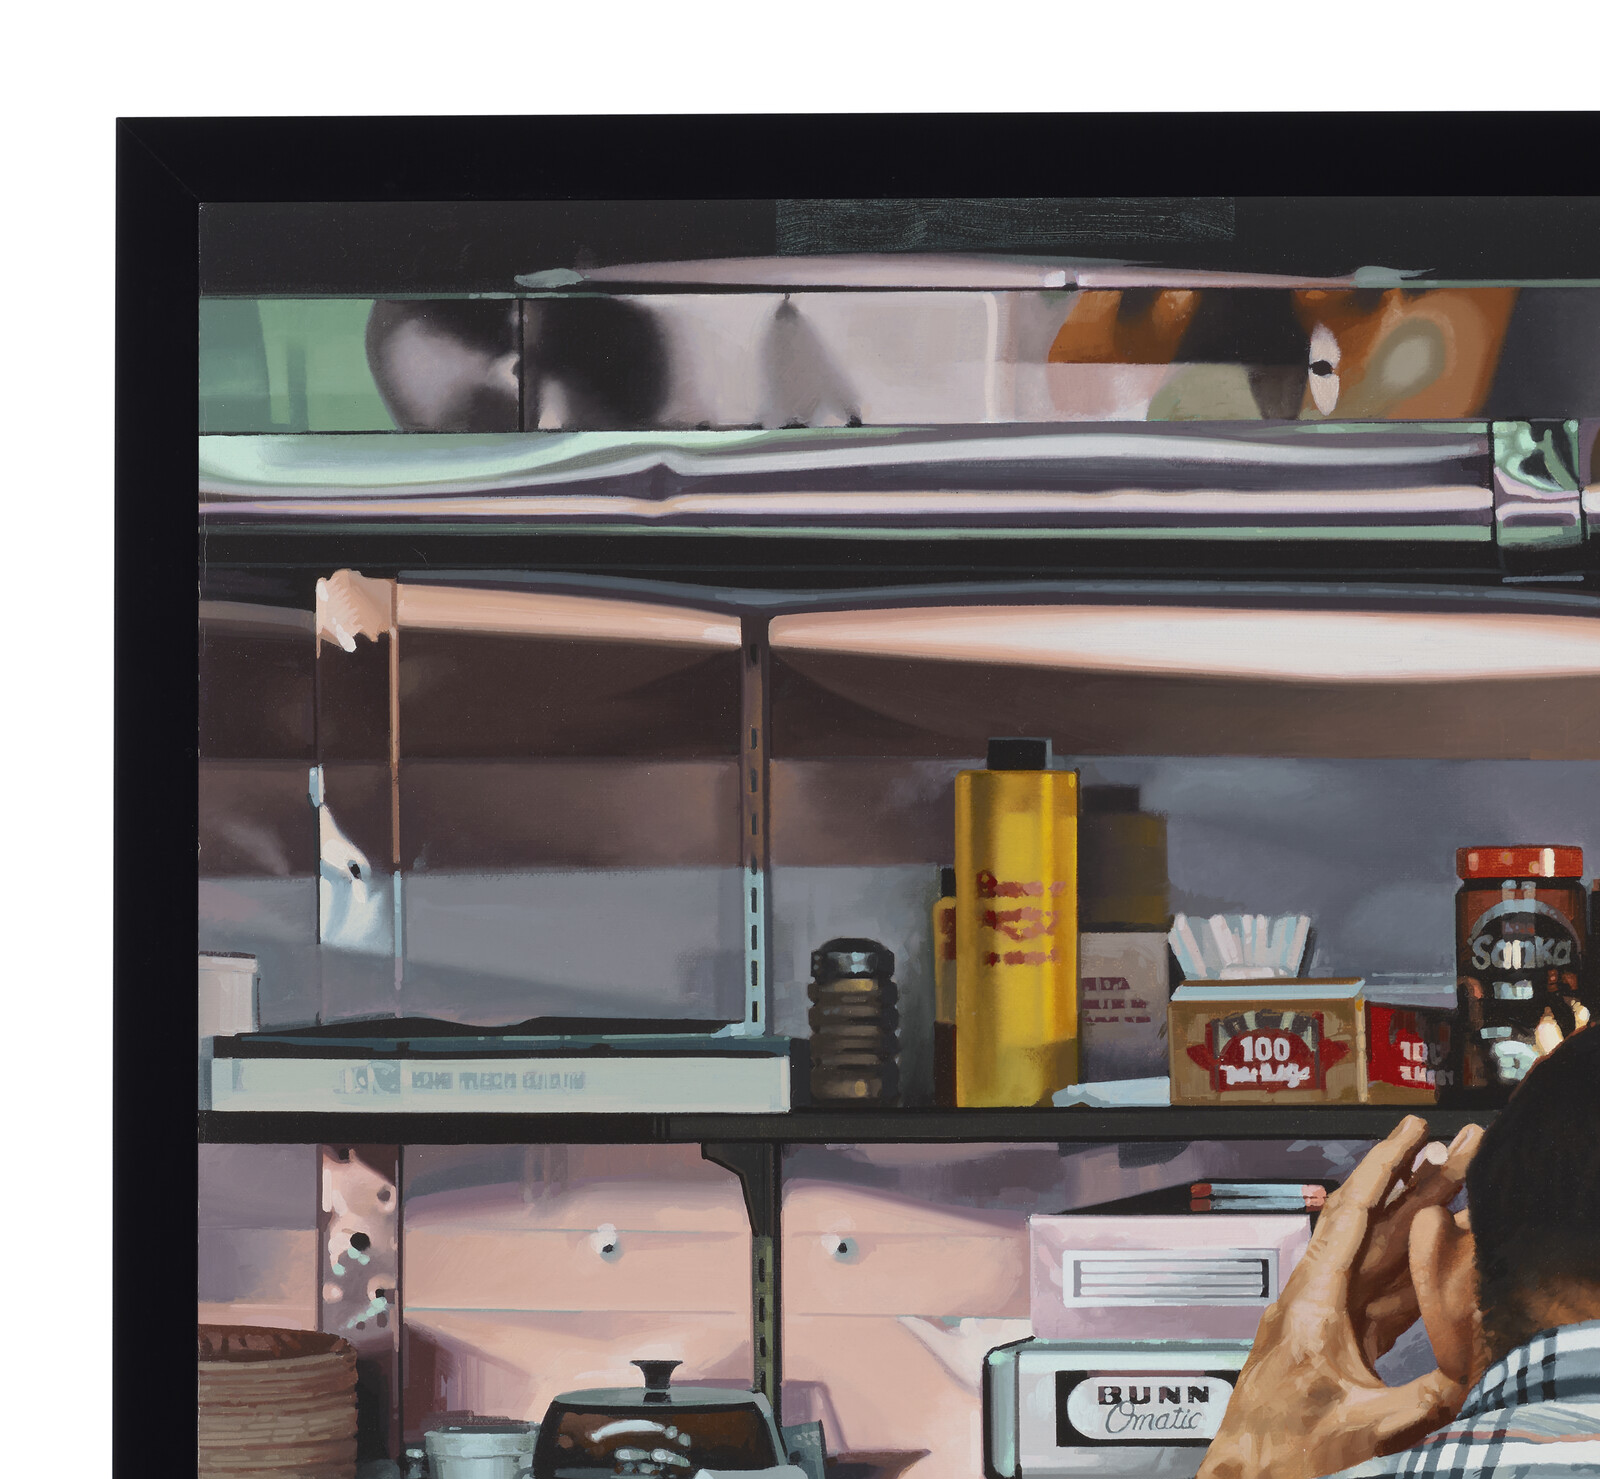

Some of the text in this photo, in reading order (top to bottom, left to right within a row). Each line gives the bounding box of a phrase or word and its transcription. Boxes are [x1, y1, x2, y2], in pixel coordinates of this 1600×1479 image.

[1471, 934, 1572, 970] Sanka
[1240, 1036, 1291, 1062] 100
[1097, 1386, 1210, 1405] BUNN
[1105, 1400, 1203, 1434] Omatic
